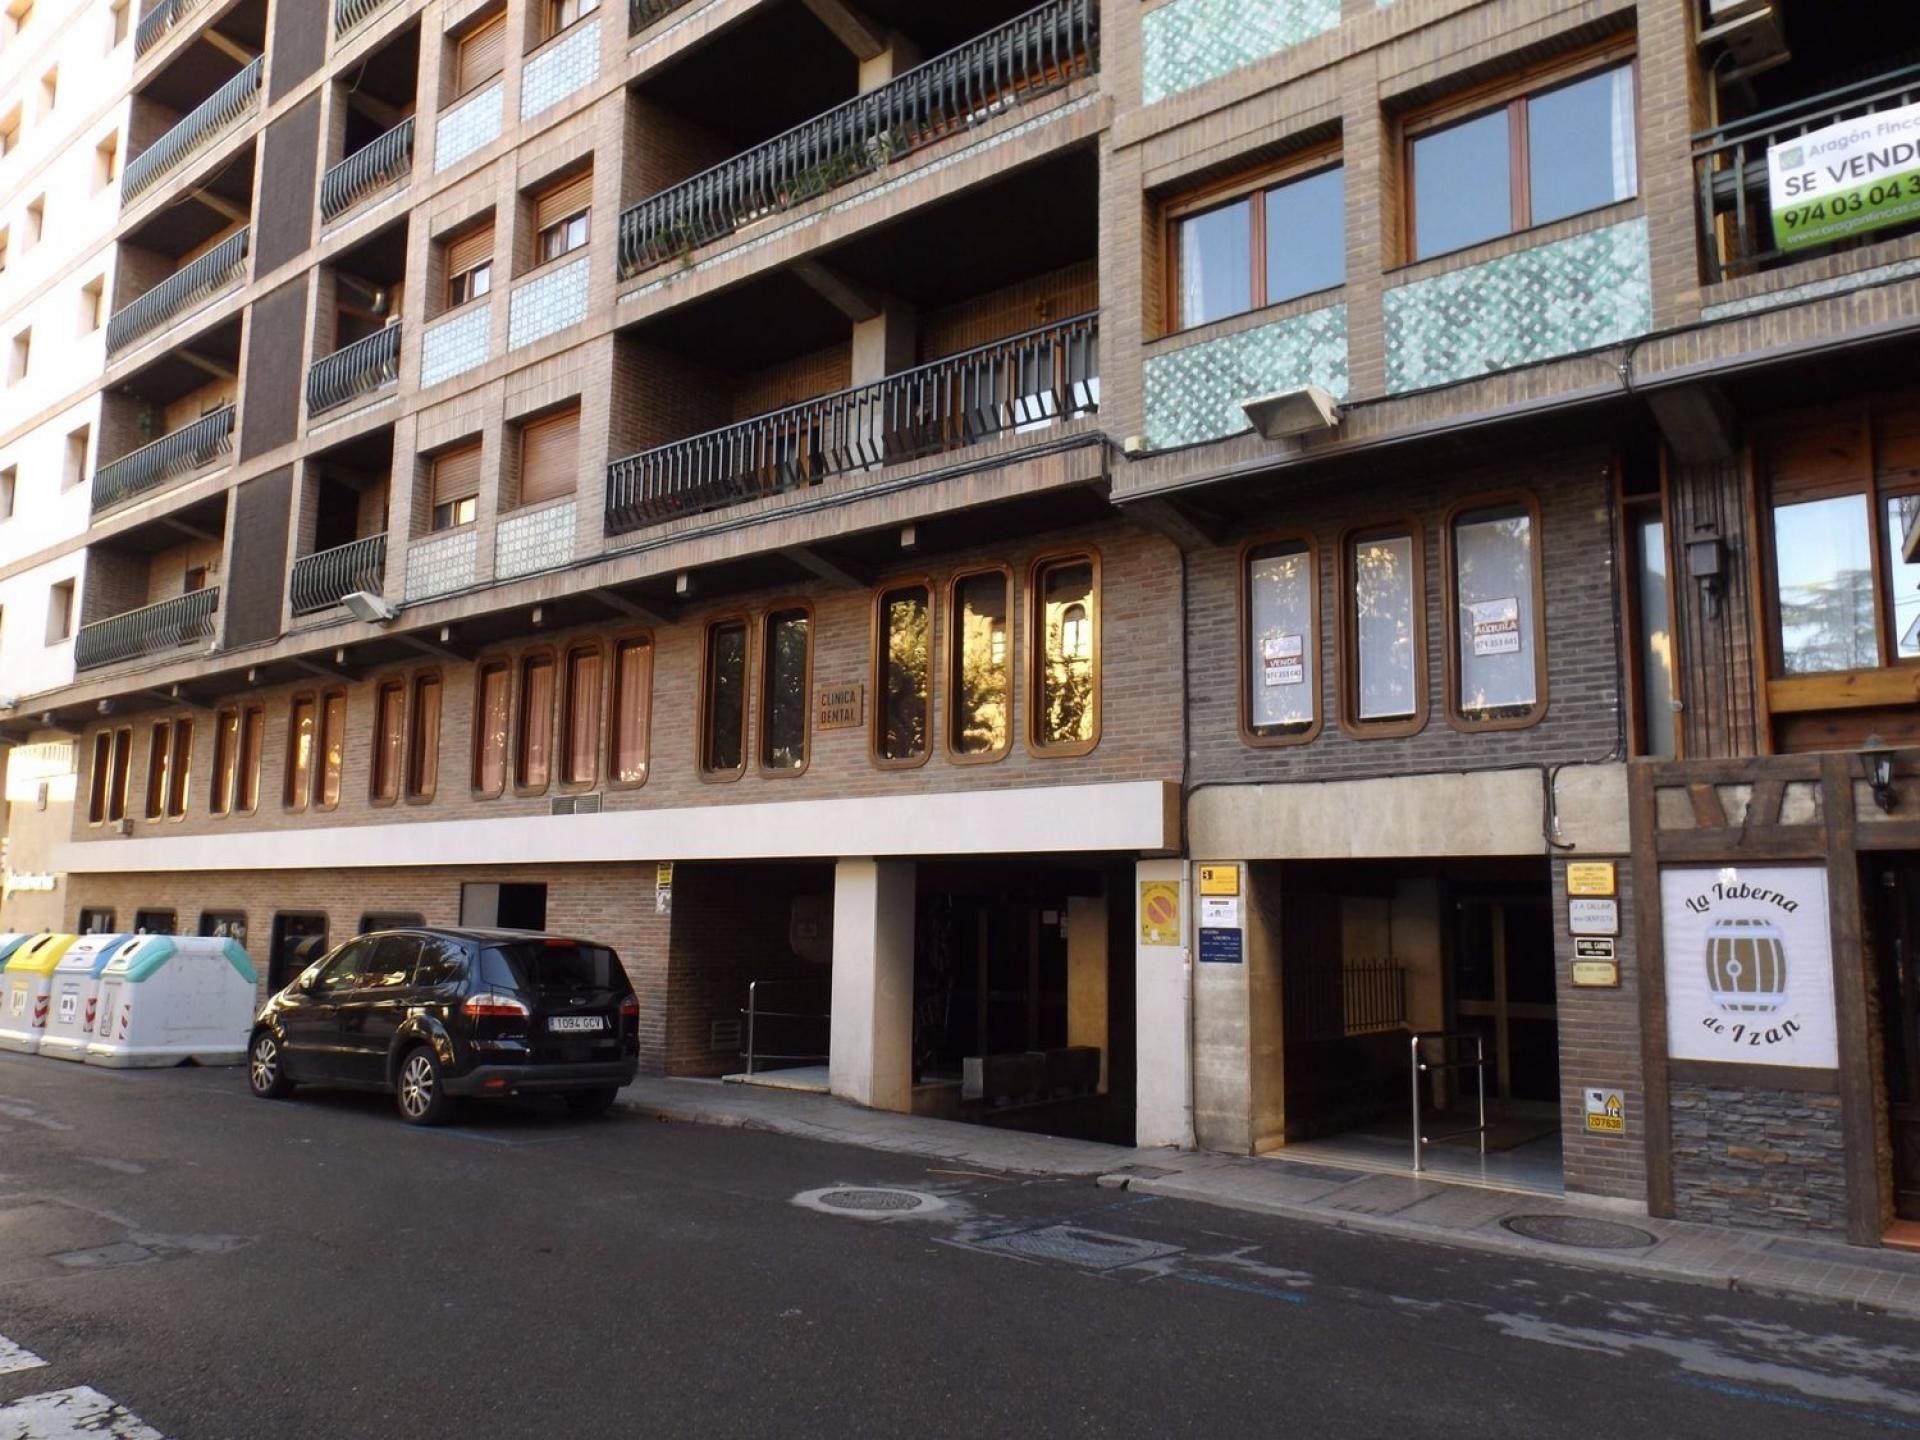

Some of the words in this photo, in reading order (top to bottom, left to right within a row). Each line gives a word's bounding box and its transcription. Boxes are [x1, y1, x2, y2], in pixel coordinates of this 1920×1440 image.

[1809, 130, 1871, 158] Aragón
[1785, 172, 1817, 197] SE
[1826, 138, 1920, 183] VEND
[1784, 203, 1826, 229] 974
[1832, 192, 1863, 216] 03
[1869, 181, 1902, 206] 04
[1270, 657, 1298, 668] VENDE
[821, 690, 856, 706] CLINICA
[821, 708, 857, 724] DENTAL
[1685, 894, 1710, 914] La
[1712, 882, 1799, 914] Taberna
[557, 1018, 580, 1029] 1094
[584, 1018, 601, 1029] GCV
[1702, 1015, 1725, 1035] de
[1732, 1019, 1800, 1046] Izan
